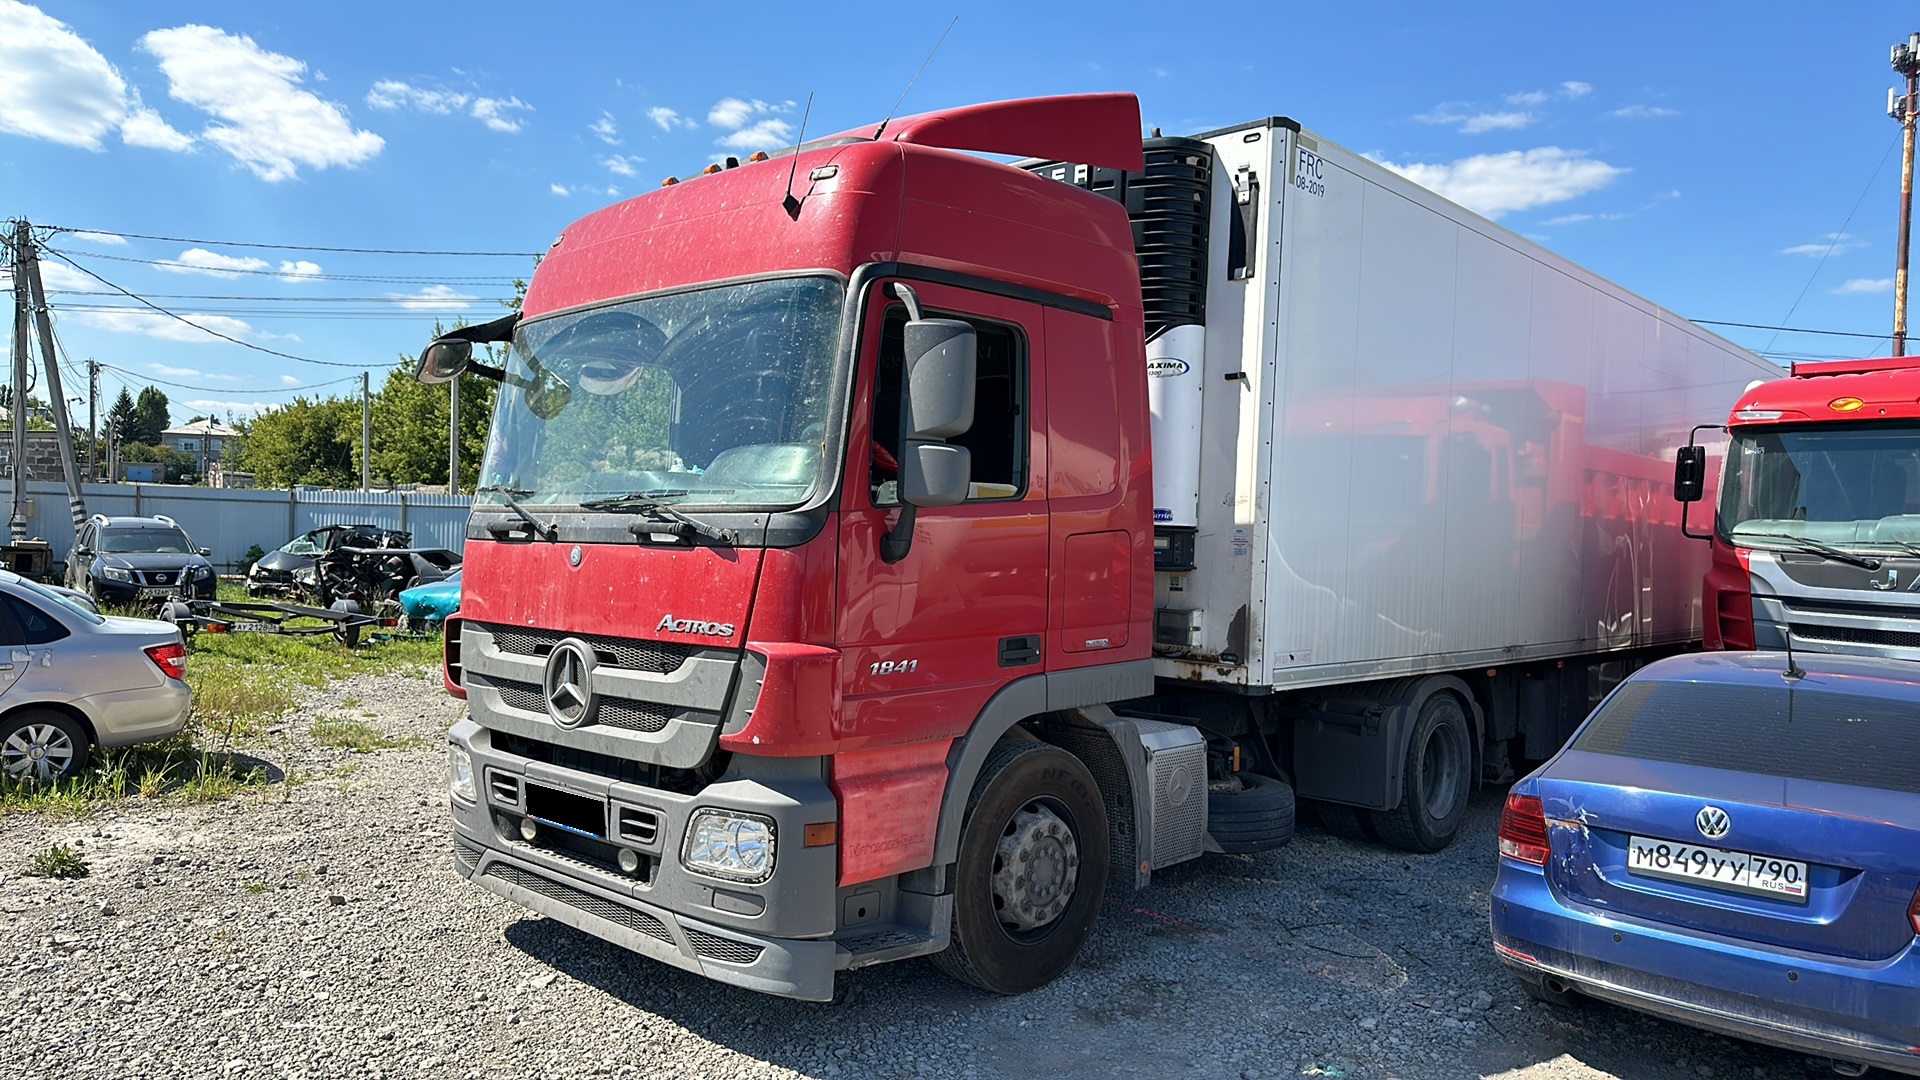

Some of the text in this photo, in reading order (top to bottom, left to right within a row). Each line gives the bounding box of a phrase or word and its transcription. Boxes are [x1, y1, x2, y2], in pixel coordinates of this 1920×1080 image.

[1299, 150, 1323, 180] FRC
[1295, 174, 1325, 198] 08-2019
[655, 613, 735, 637] ACTROS
[869, 659, 918, 676] 1841
[1752, 857, 1800, 885] 790
[1761, 879, 1785, 891] RUS
